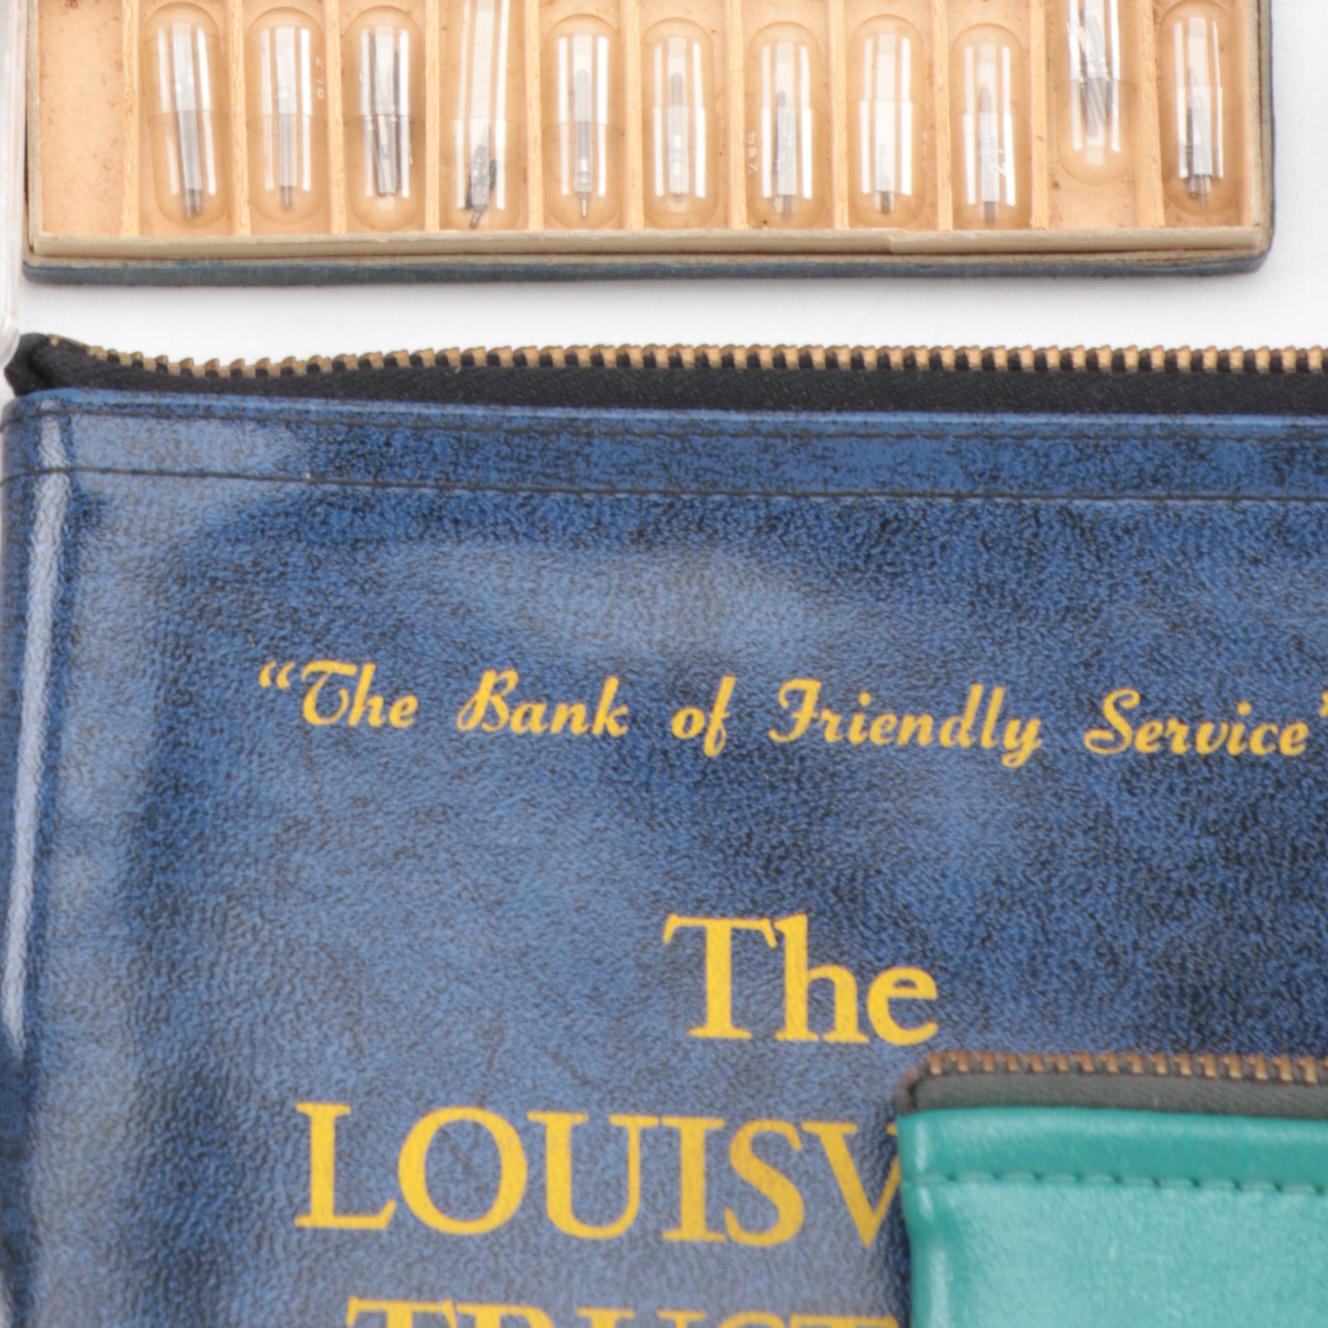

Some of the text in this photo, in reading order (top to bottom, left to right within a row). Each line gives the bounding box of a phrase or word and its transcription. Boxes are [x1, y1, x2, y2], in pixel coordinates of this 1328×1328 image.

[456, 669, 629, 738] Bank
[671, 676, 734, 756] of
[767, 679, 1042, 768] Friendly
[662, 914, 938, 1046] The
